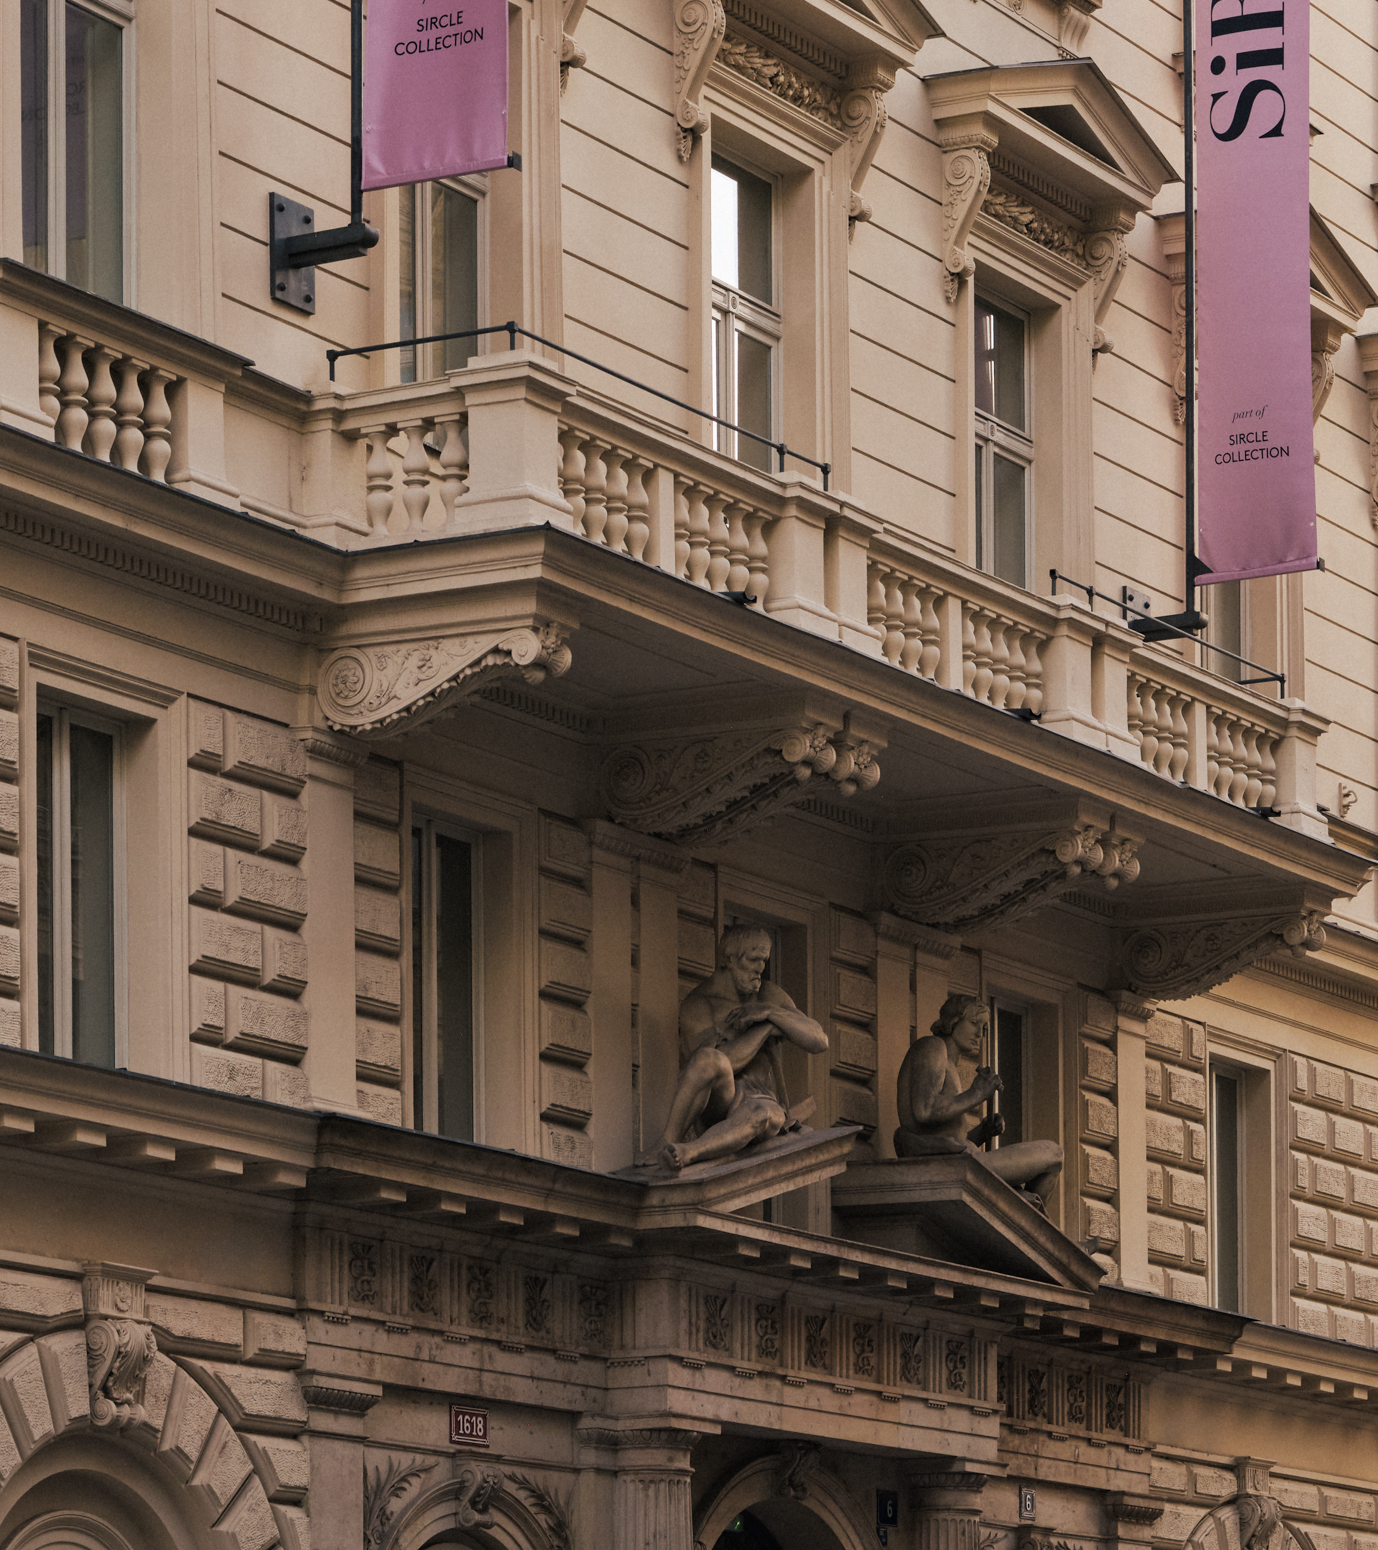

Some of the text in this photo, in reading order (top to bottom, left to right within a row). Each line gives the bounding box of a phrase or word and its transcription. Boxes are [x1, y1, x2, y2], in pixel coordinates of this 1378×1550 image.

[416, 10, 464, 33] SIRCLE
[394, 26, 484, 56] COLLECTION
[1231, 404, 1269, 424] part of
[1228, 430, 1269, 446] SIRCLE
[1214, 445, 1290, 465] COLLECTION
[457, 1414, 484, 1437] 1618
[886, 1499, 893, 1518] 6
[1026, 1494, 1032, 1511] 6
